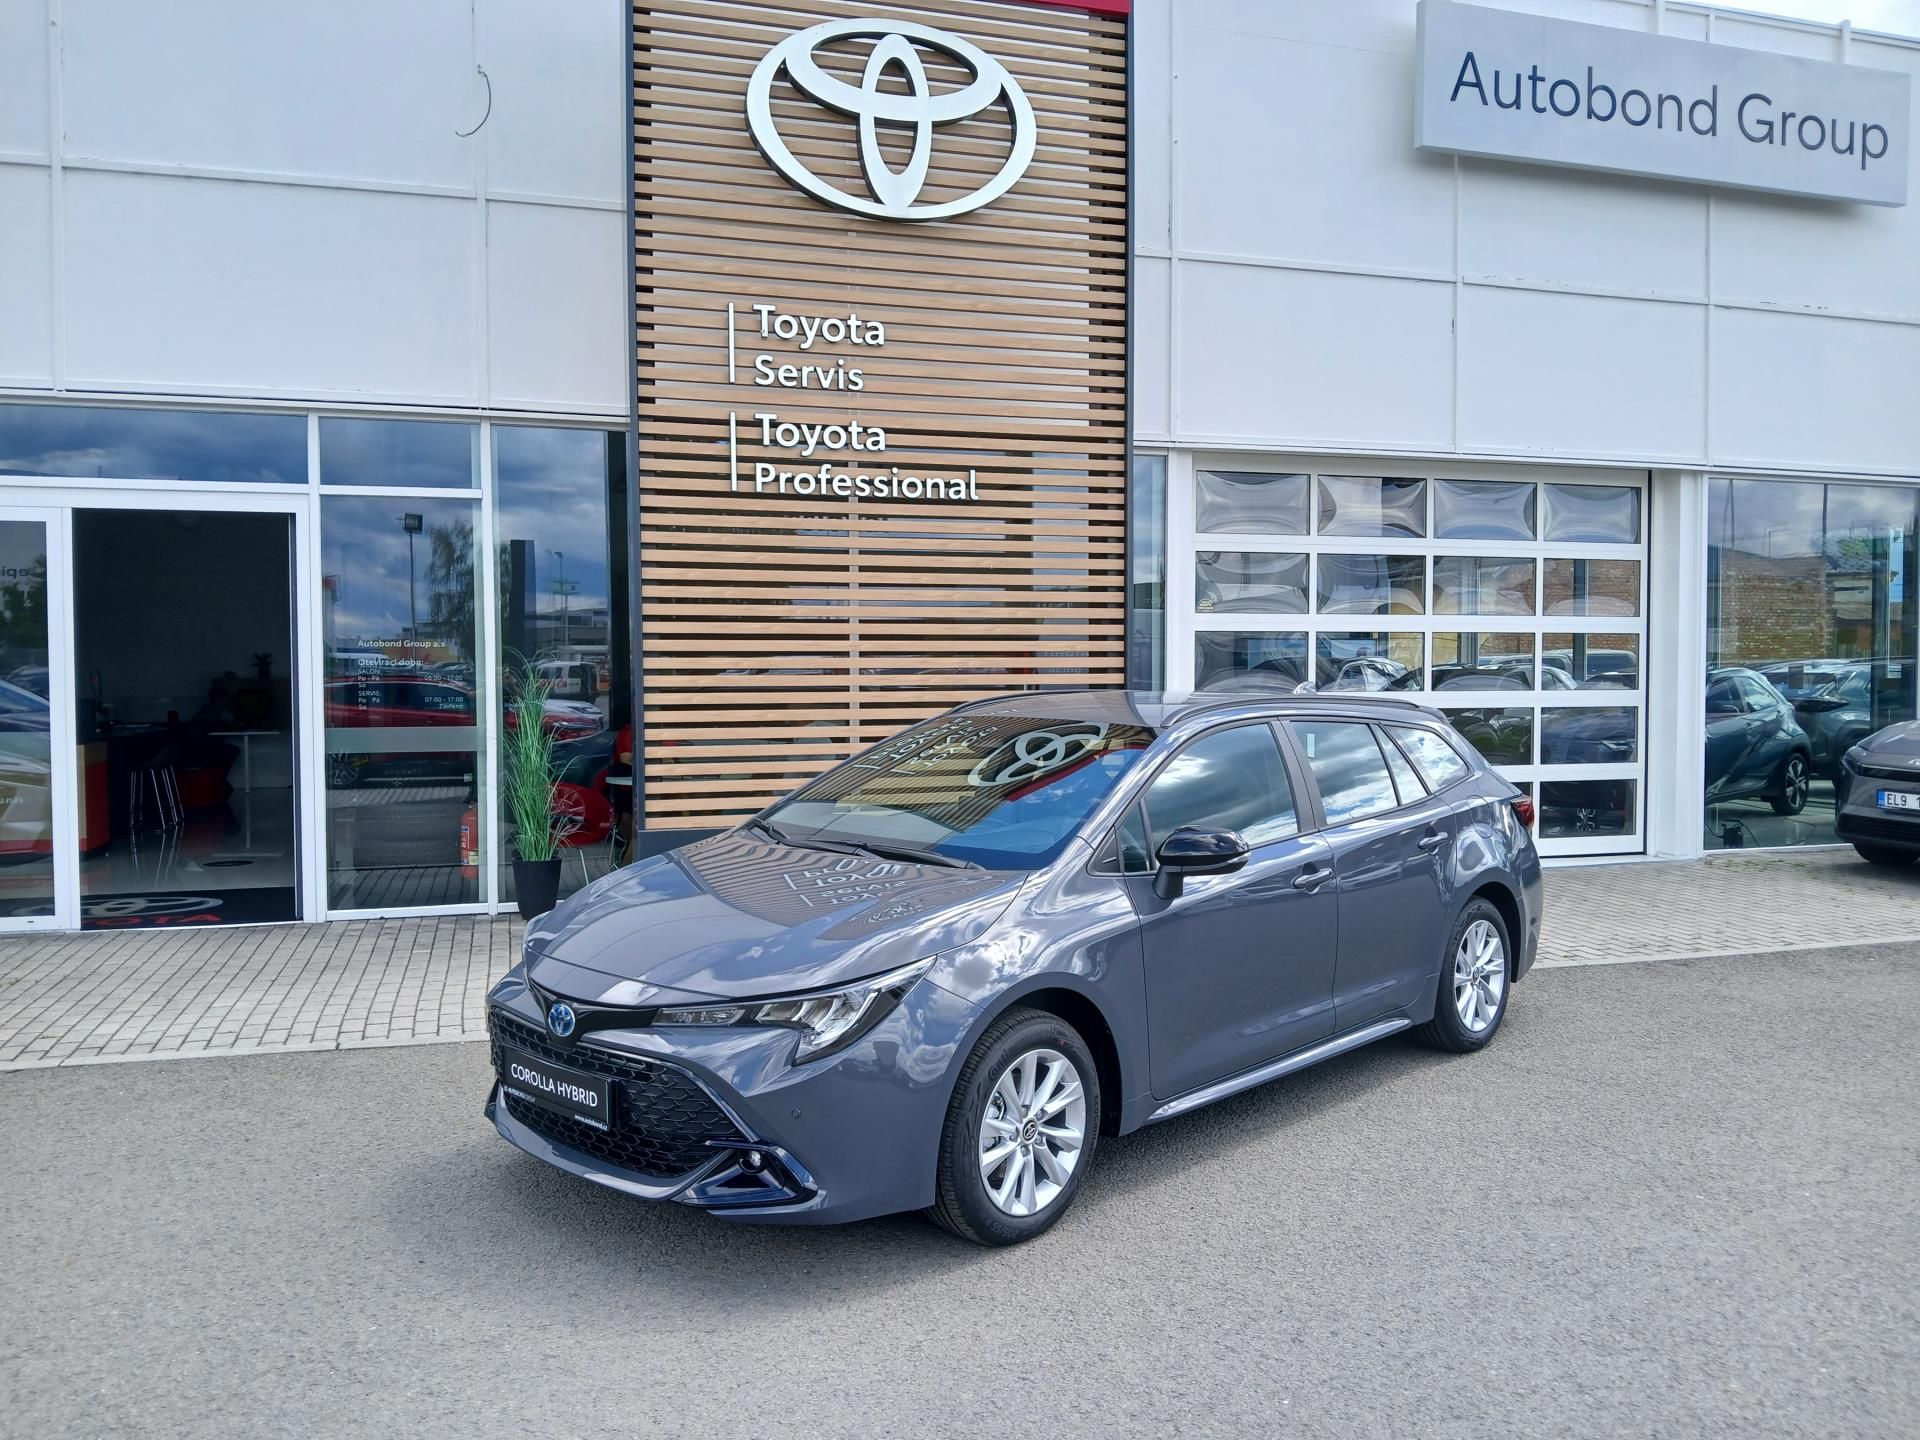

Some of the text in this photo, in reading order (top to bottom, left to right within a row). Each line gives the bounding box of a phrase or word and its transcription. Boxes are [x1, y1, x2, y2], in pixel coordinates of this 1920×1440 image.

[1451, 51, 1889, 170] Autobond Group
[752, 303, 886, 350] Toyota
[754, 354, 865, 392] Servis
[754, 413, 886, 457] Toyota
[755, 462, 980, 501] Professional
[357, 639, 402, 648] Autobond
[403, 640, 431, 649] Group
[1886, 793, 1907, 806] EL9
[511, 1063, 598, 1108] COROLLA HYBRID
